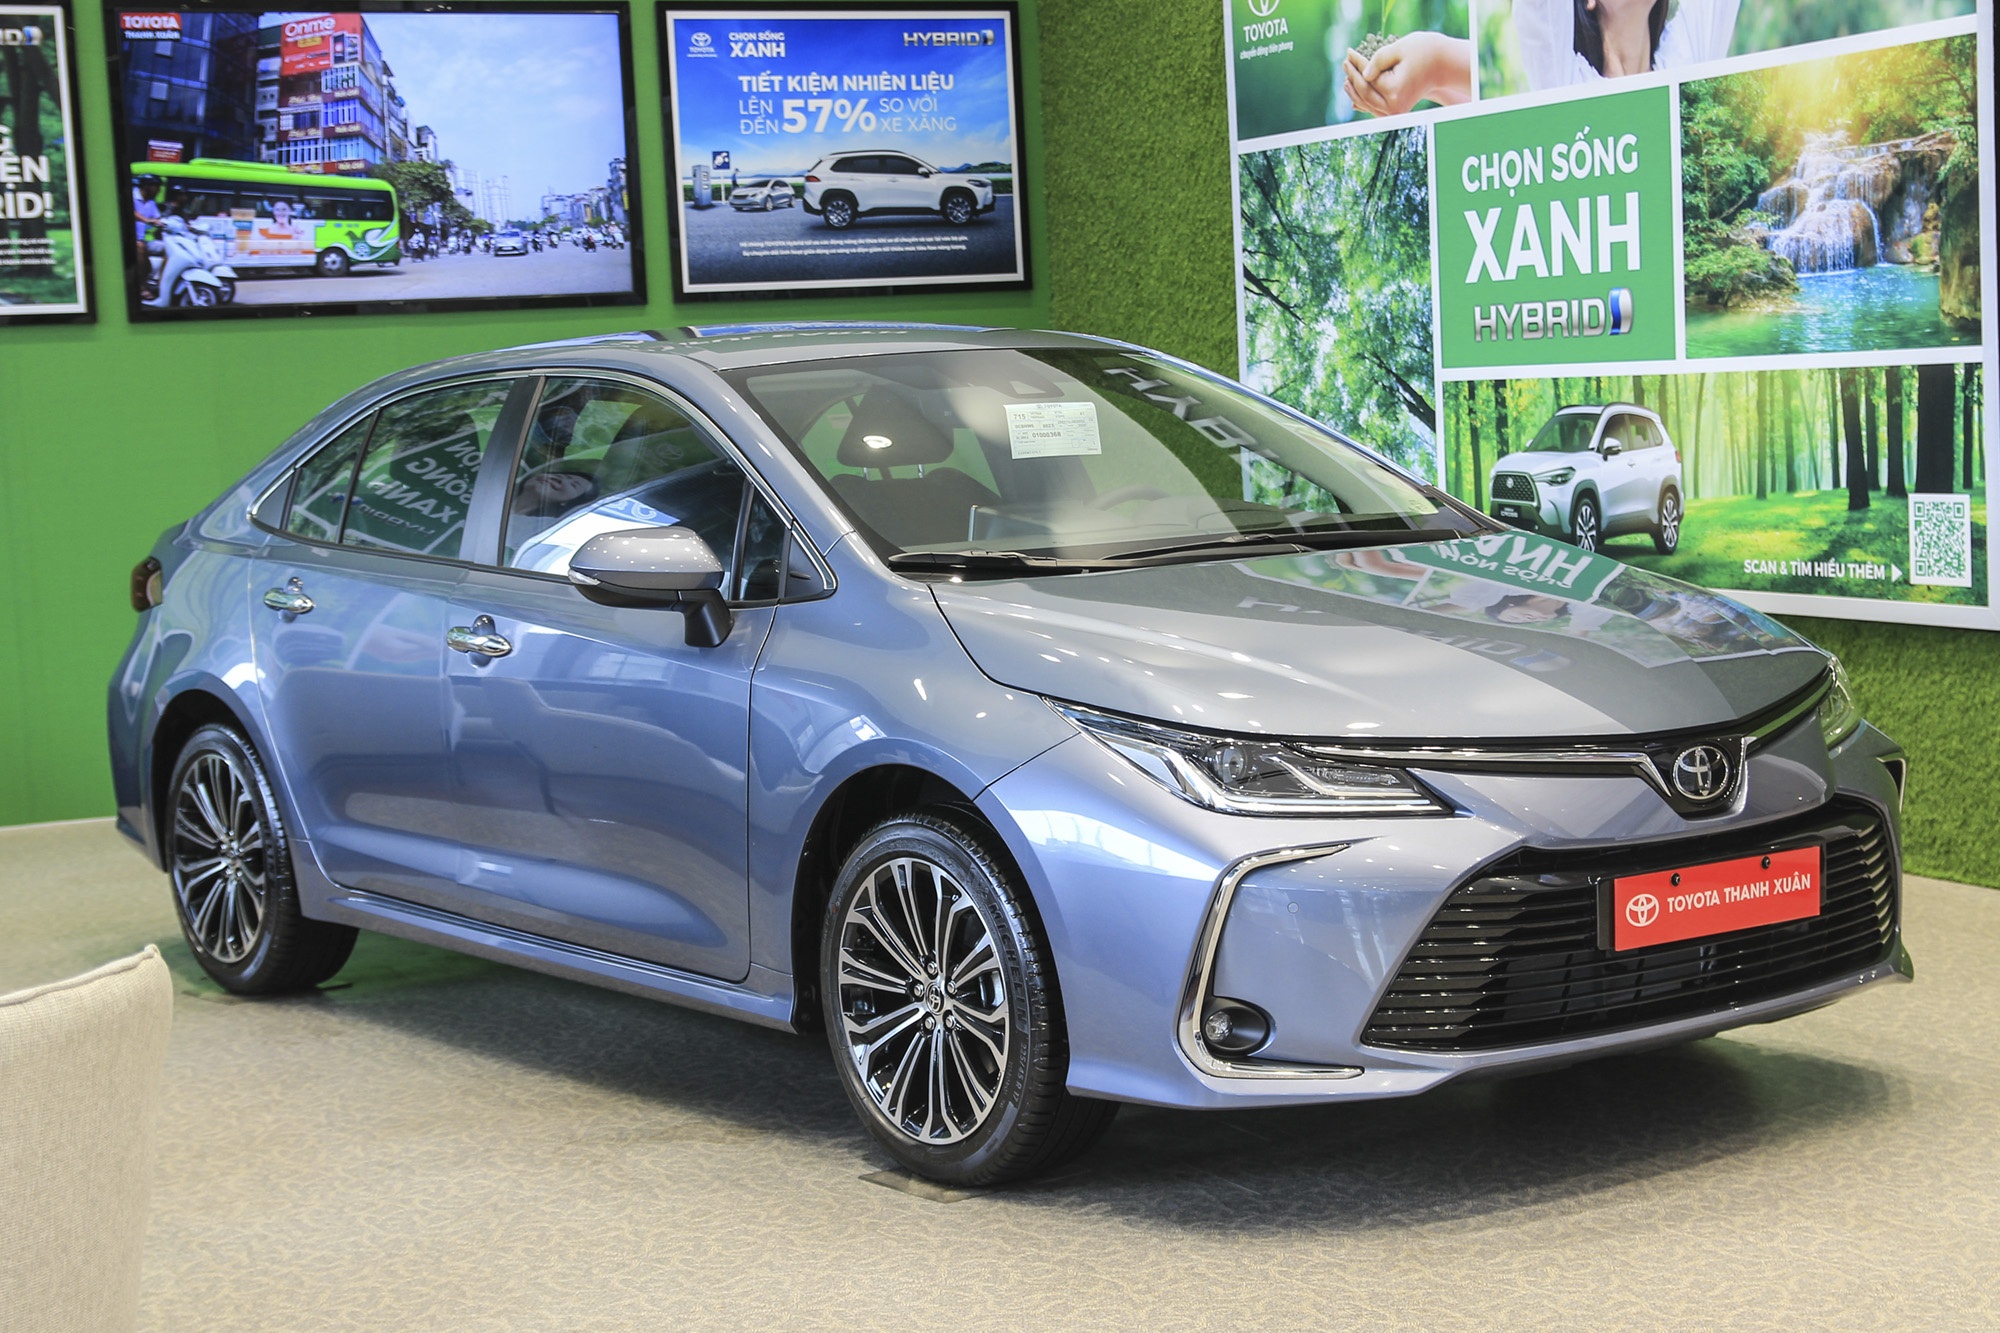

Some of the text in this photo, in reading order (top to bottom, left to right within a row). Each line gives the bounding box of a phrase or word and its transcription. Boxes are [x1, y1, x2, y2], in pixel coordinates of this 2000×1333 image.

[123, 15, 180, 29] TOYOTA
[1243, 17, 1289, 43] TOYOTA
[728, 30, 785, 42] CHỌN SỐNG
[903, 31, 980, 47] HYBRID
[730, 42, 786, 58] XANH
[738, 70, 954, 96] TIẾT KIỆM NHIÊN LIỆU
[739, 95, 773, 115] LÊN
[782, 98, 876, 133] 57%
[879, 98, 904, 113] SO
[740, 113, 779, 134] ĐẾN
[880, 113, 957, 133] XE XĂNG
[1461, 126, 1639, 198] CHỌN SỐNG
[1463, 192, 1641, 284] XANH
[1474, 298, 1606, 342] HYBRID
[1743, 557, 1886, 580] SCAN & TÌM HIỂU THÊM
[1667, 872, 1811, 913] TOYOTA THANH XUÂN
[987, 902, 1029, 1022] MICHELIN
